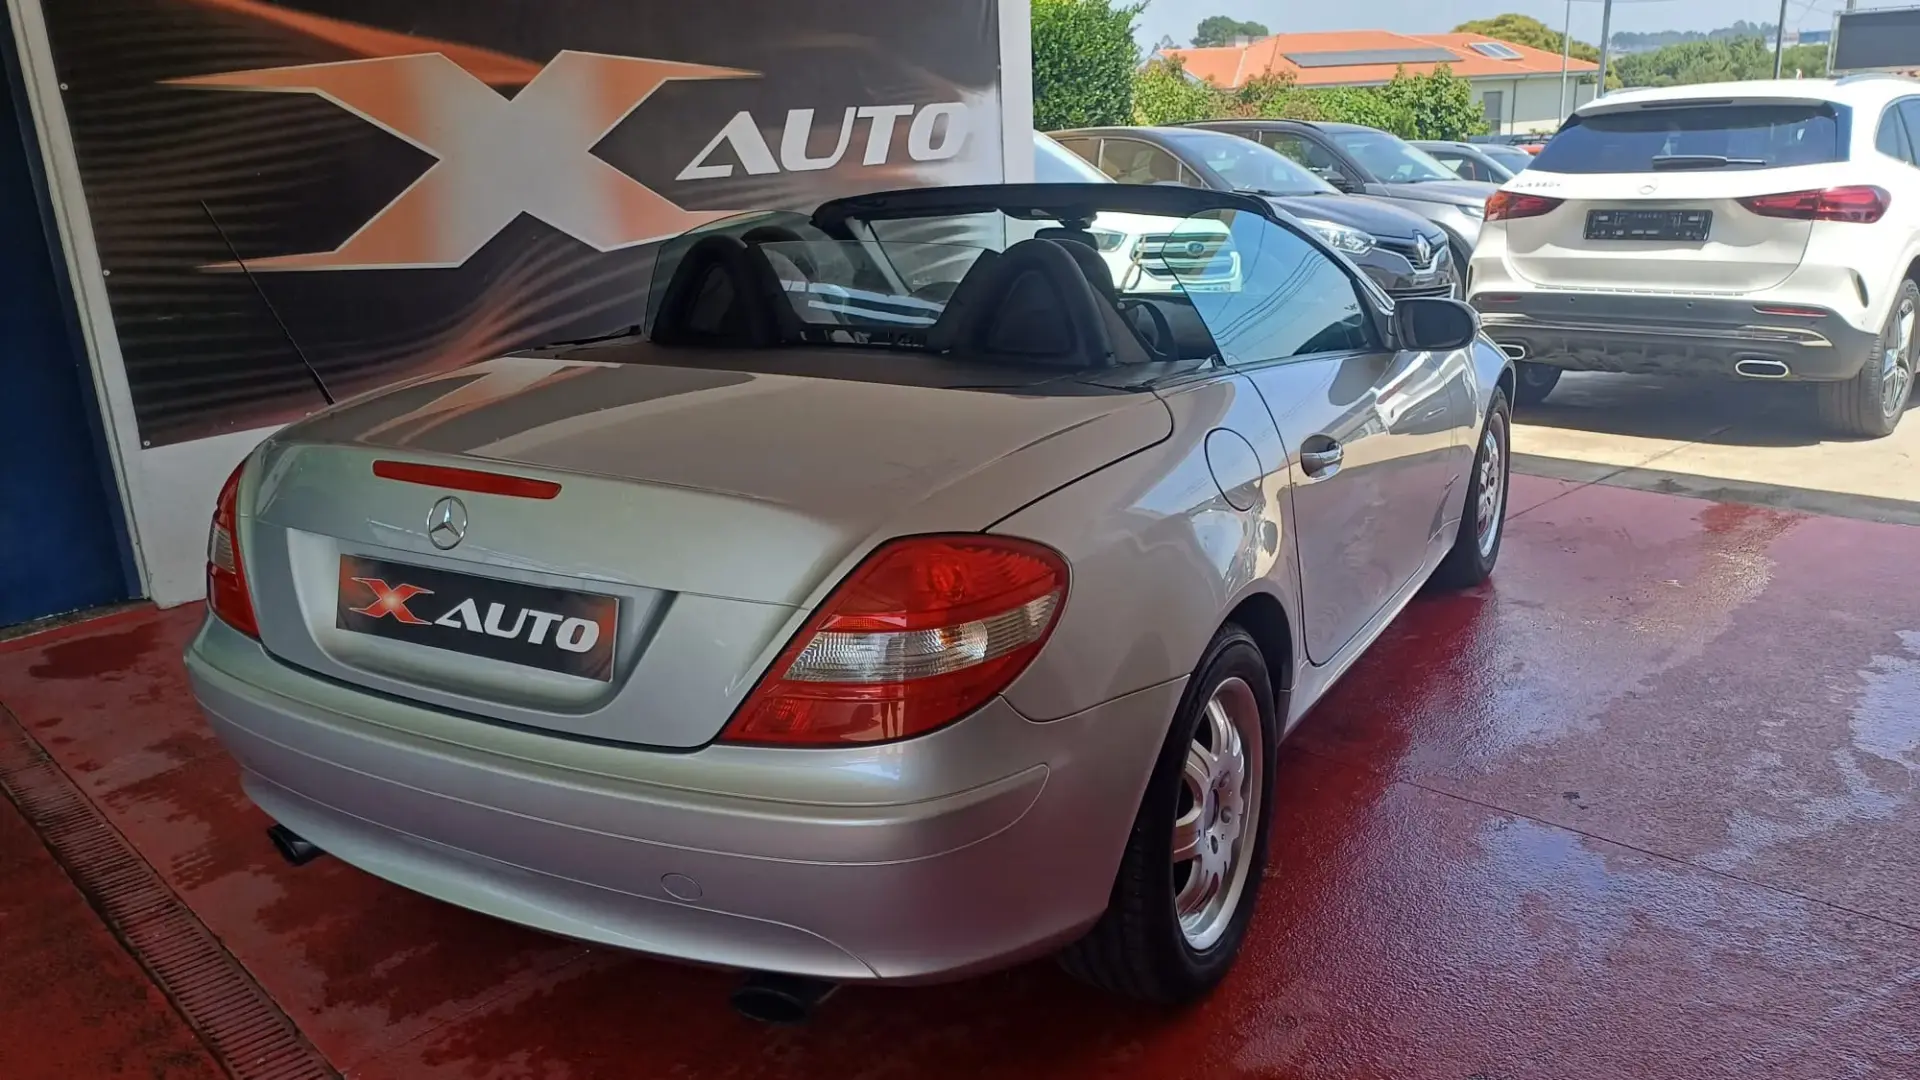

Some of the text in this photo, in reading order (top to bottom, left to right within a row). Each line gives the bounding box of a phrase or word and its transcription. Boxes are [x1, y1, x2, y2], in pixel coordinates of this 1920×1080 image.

[155, 50, 970, 269] X AUTO
[349, 576, 600, 653] X AUTO
